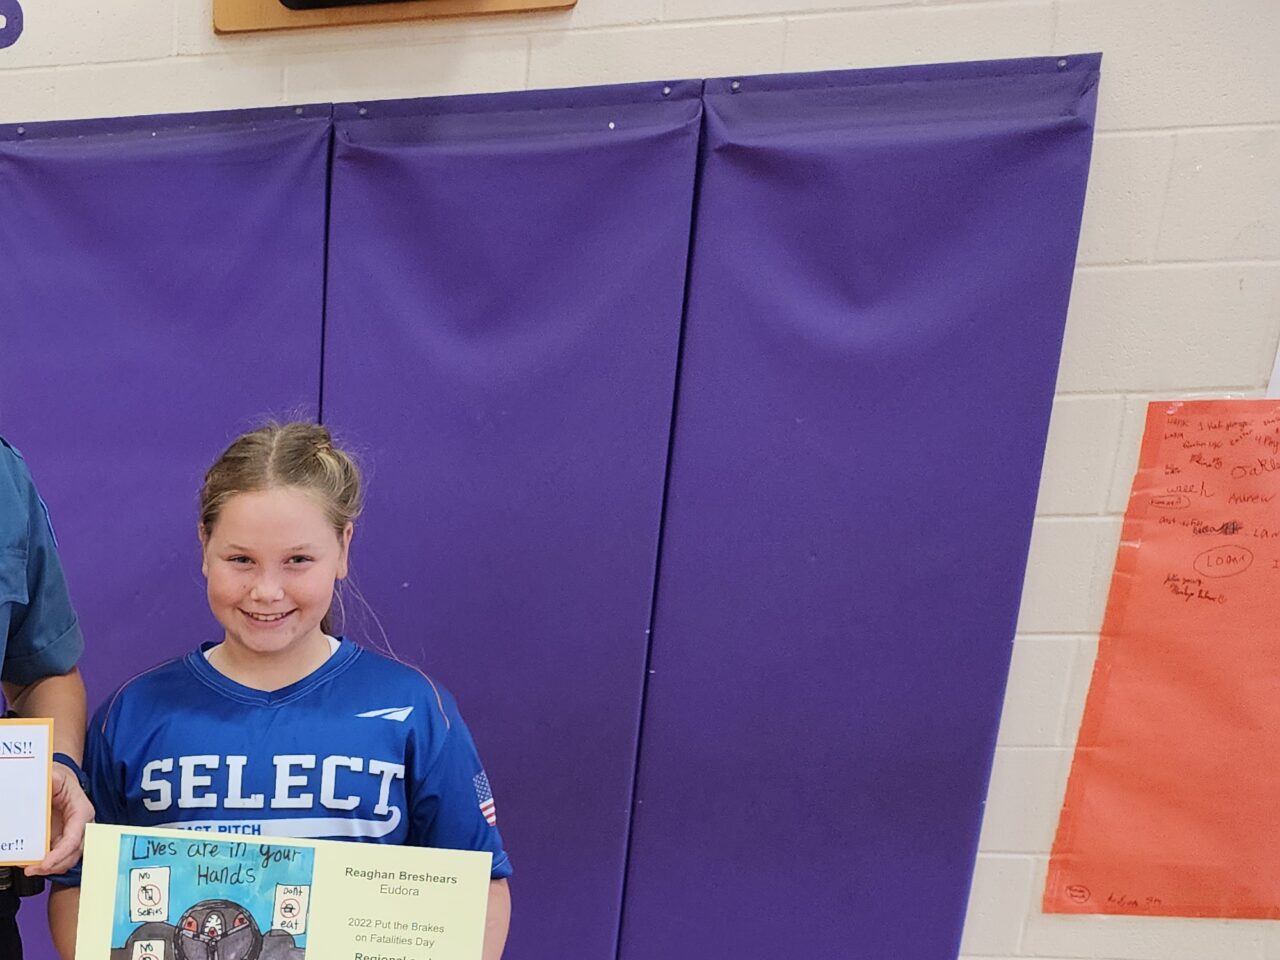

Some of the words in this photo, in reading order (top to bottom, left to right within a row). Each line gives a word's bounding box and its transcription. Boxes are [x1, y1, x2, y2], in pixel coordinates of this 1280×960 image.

[140, 754, 406, 815] SELECT
[132, 835, 177, 861] Lives
[187, 842, 219, 858] are
[229, 840, 247, 857] in
[197, 864, 256, 886] Hands
[345, 867, 395, 881] Reaghan
[399, 871, 458, 884] Breshears
[379, 884, 420, 896] Eudora
[348, 917, 372, 928] 2022
[375, 919, 391, 929] Put
[393, 920, 409, 931] the
[411, 922, 445, 933] Brakes
[370, 934, 413, 946] Fatalities
[415, 937, 435, 948] Day
